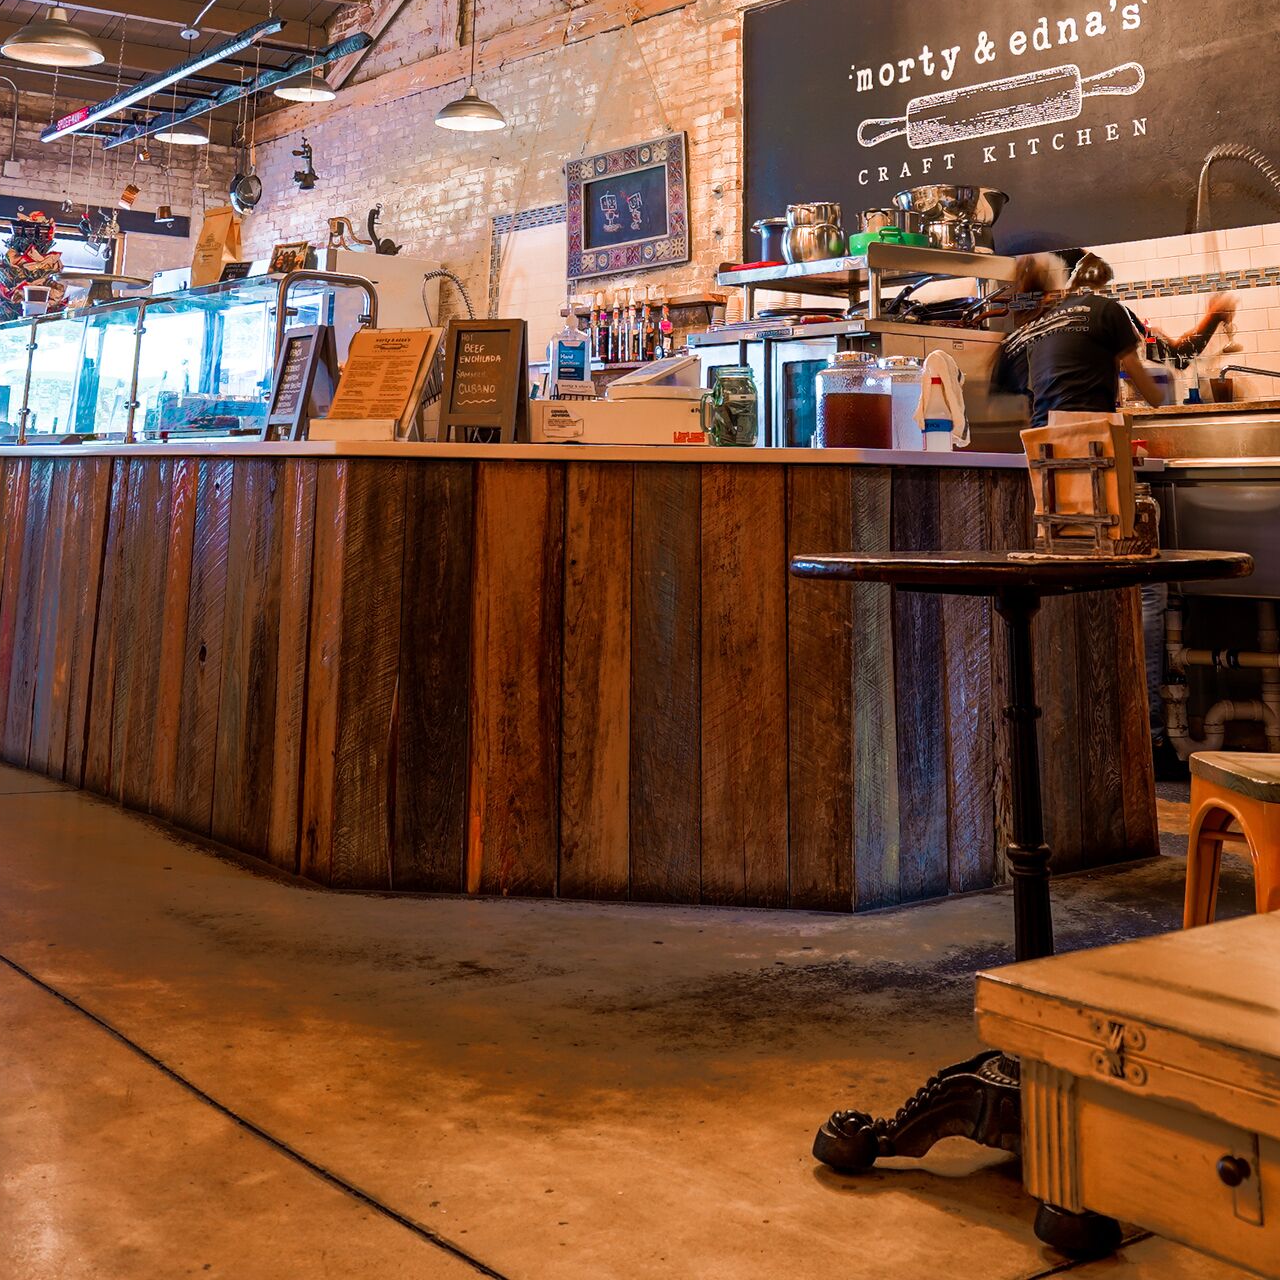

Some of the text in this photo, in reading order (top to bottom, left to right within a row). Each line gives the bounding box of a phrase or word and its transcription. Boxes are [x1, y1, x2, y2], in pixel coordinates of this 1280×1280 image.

[856, 44, 961, 93] morty
[973, 30, 997, 65] &
[857, 117, 1148, 186] CRAFT KITCHEN
[464, 343, 486, 354] BEEF
[459, 354, 502, 365] ENCHILADA
[458, 383, 496, 395] CUBANO
